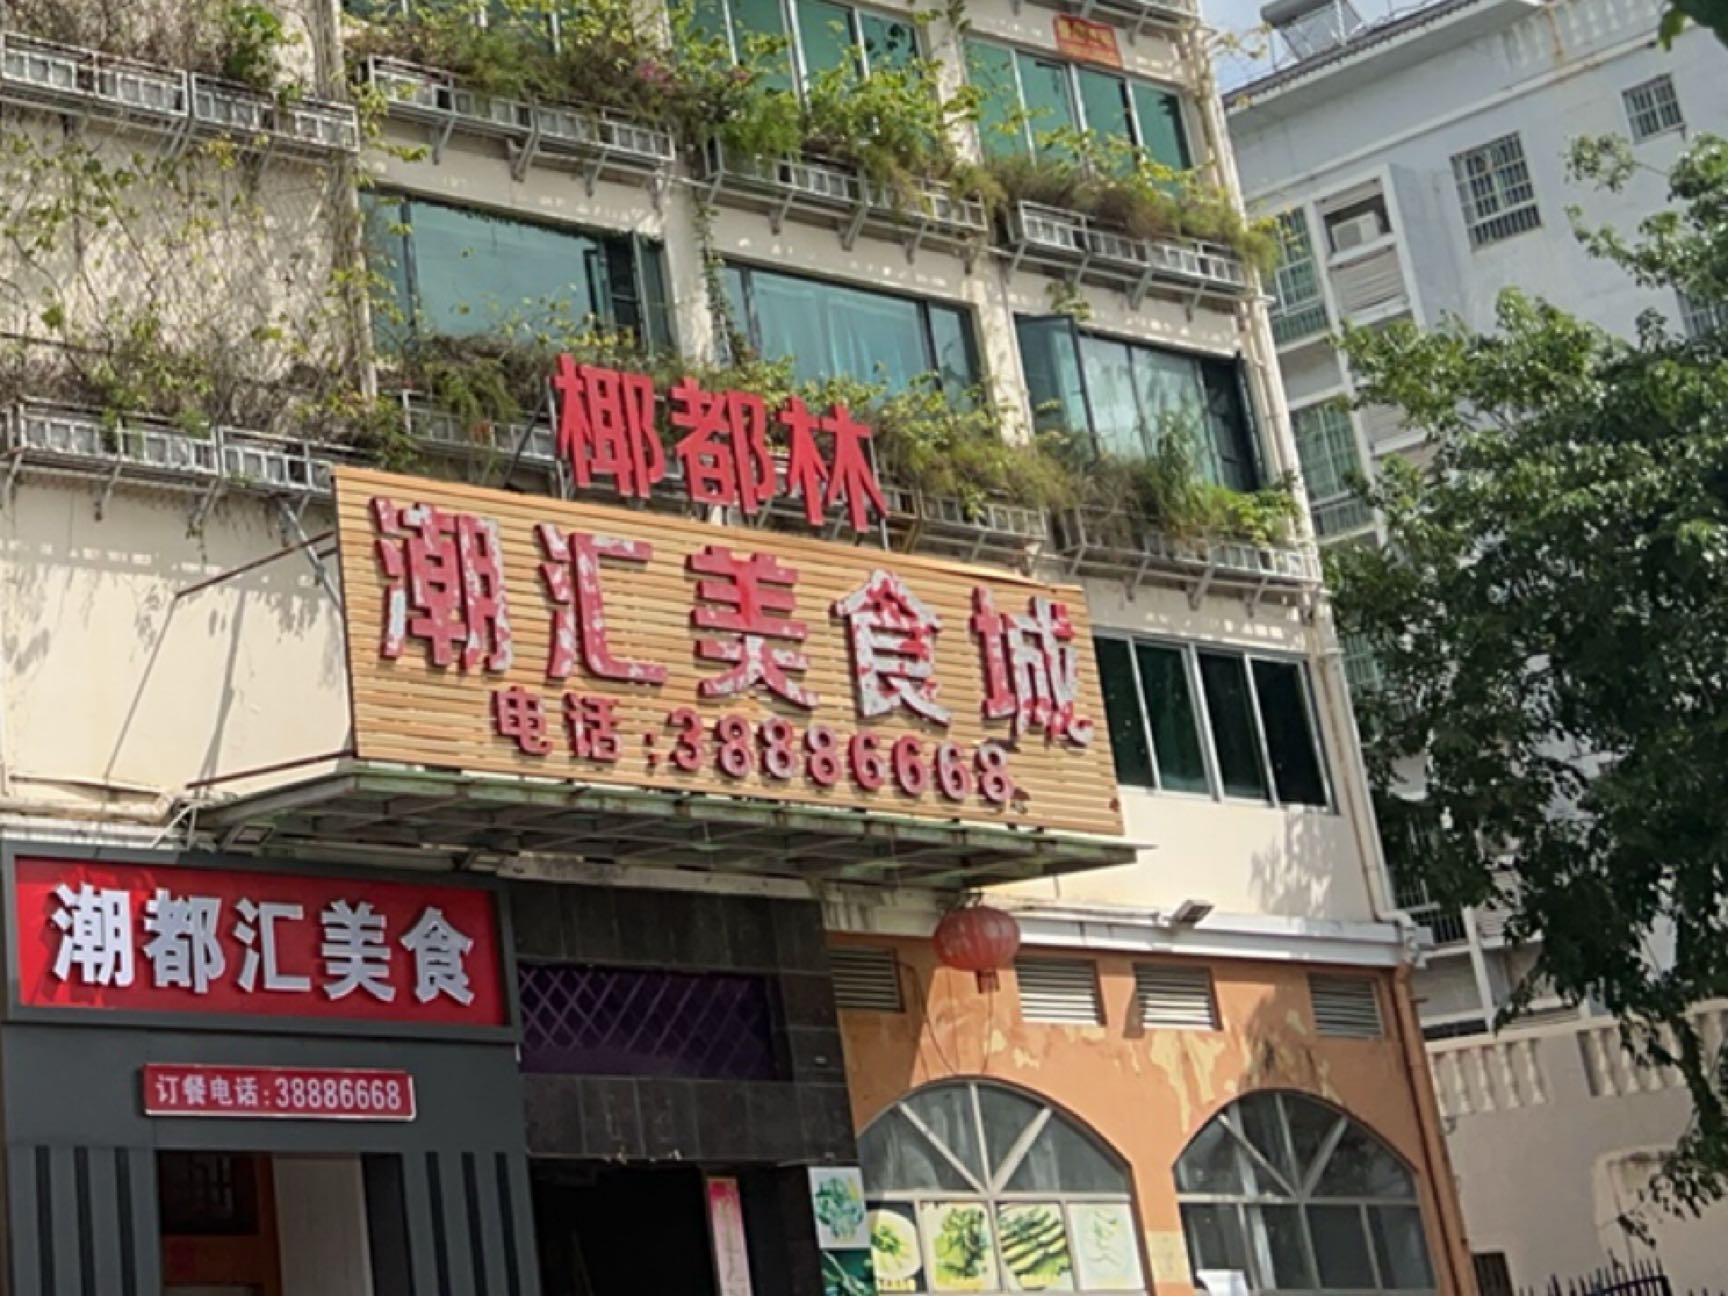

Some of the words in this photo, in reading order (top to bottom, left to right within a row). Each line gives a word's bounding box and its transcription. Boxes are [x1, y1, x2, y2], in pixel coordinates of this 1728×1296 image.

[553, 352, 889, 533] 椰都林
[372, 496, 1095, 747] 潮汇美食城
[48, 882, 475, 1006] 潮都汇美食
